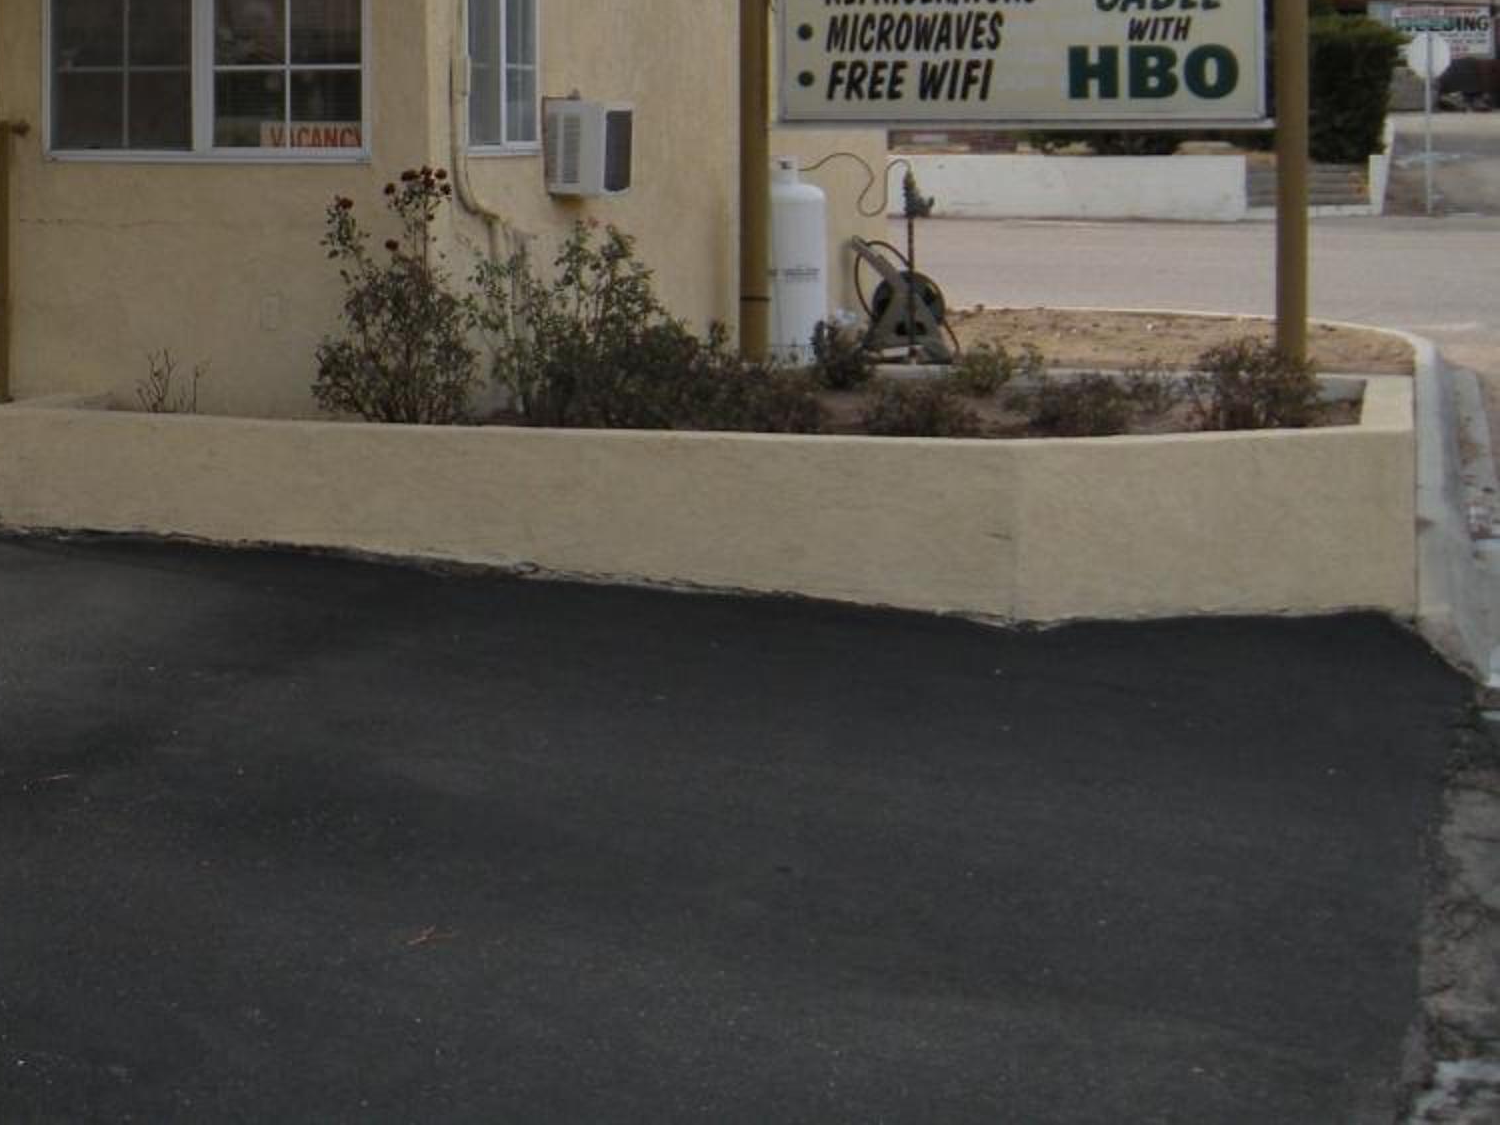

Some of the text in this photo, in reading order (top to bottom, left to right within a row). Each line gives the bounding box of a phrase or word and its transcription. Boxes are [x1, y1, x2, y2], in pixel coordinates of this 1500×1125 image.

[825, 11, 1005, 53] MICROWAVES
[1127, 16, 1192, 42] WITH
[825, 58, 995, 102] FREE WIFI
[1066, 44, 1240, 100] HBO
